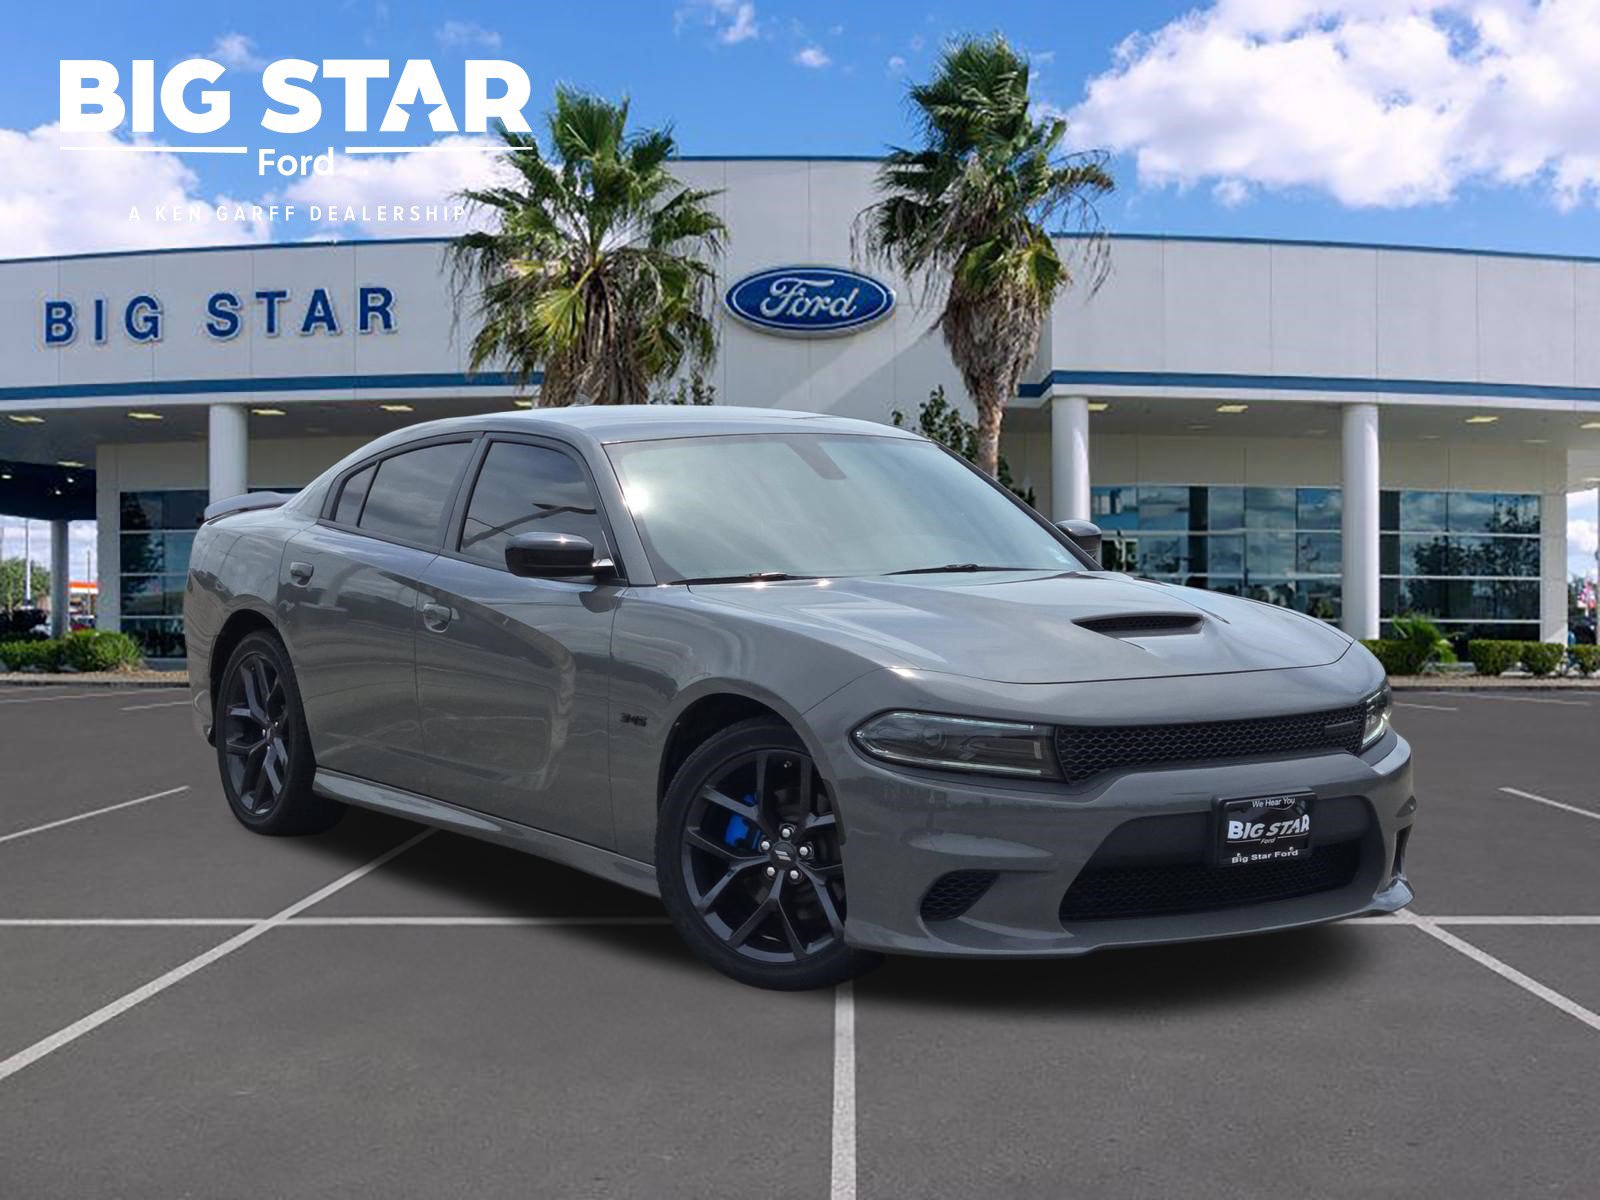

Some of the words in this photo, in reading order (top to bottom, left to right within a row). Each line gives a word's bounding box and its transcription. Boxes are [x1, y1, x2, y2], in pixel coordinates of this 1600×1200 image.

[760, 277, 860, 317] Ford
[44, 294, 164, 345] BIG
[205, 286, 398, 339] STAR
[1252, 799, 1264, 808] We
[1265, 798, 1281, 807] Hear
[1283, 796, 1296, 806] You
[1227, 820, 1264, 839] BIG
[1266, 814, 1310, 836] STAR
[1231, 854, 1249, 864] Big
[1250, 853, 1272, 861] Star
[1274, 849, 1299, 858] Ford
